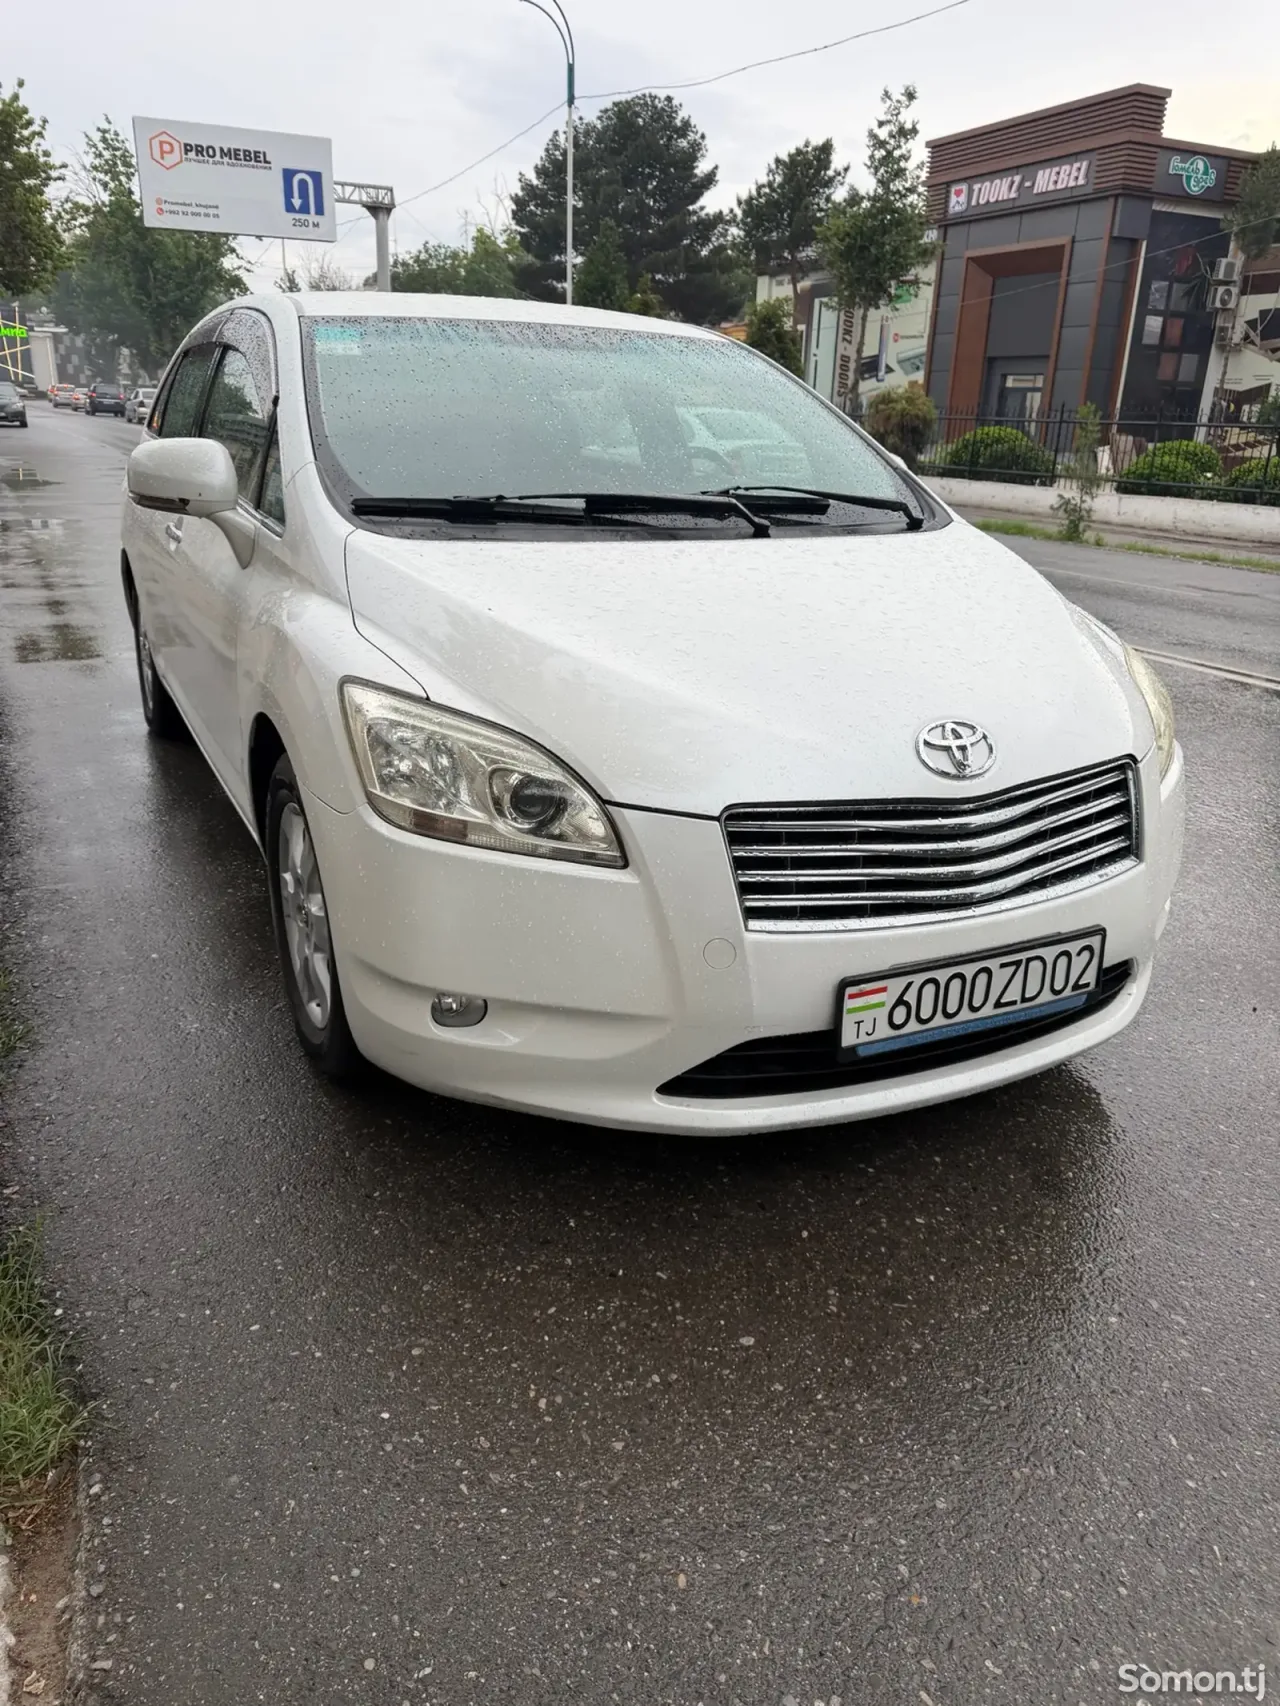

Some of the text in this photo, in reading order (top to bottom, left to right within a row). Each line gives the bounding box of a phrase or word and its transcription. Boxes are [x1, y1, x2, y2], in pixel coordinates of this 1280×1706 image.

[183, 142, 272, 165] PRO MEBEL
[971, 174, 1023, 206] TOOKZ
[1033, 160, 1090, 195] MEBEL
[291, 217, 310, 228] 250
[837, 354, 851, 397] DOORS
[887, 944, 1096, 1031] 6000ZD02
[854, 1017, 877, 1039] TJ
